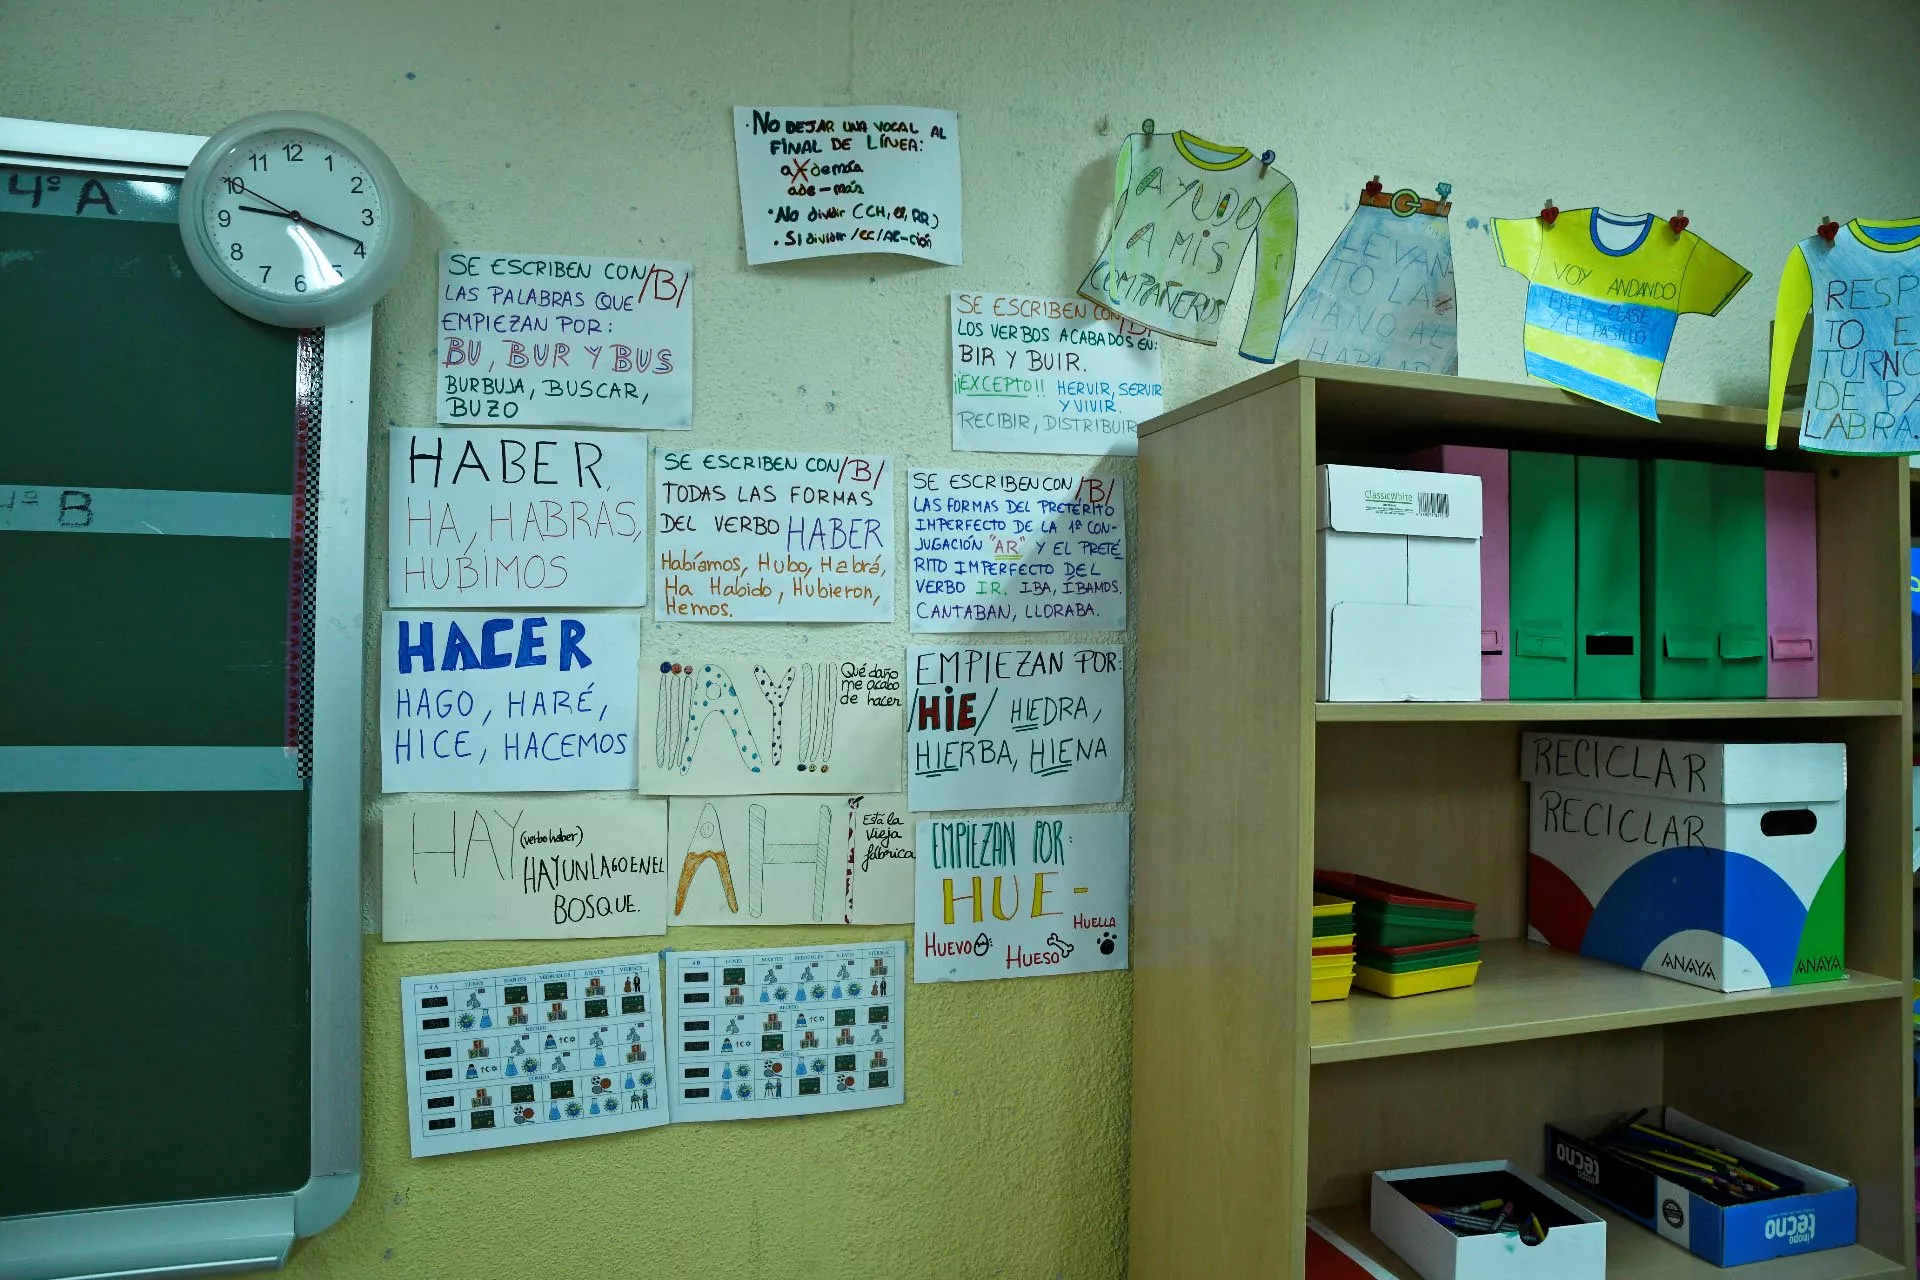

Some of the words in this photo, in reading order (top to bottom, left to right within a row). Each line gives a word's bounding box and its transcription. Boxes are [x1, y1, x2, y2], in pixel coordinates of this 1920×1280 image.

[786, 120, 834, 134] DEJAR
[842, 120, 867, 133] UNA
[874, 121, 918, 134] VOCAL
[931, 125, 946, 139] AL
[282, 145, 303, 162] 12
[831, 138, 852, 150] DE
[249, 154, 267, 171] 11
[325, 155, 332, 171] 1
[226, 177, 244, 194] 10
[351, 177, 363, 193] 2
[76, 179, 118, 215] A
[1136, 167, 1261, 230] AYUDO
[218, 210, 230, 227] 9
[362, 209, 373, 226] 3
[354, 242, 366, 258] 4
[1127, 223, 1154, 257] A
[230, 243, 243, 261] 8
[260, 266, 271, 283] 7
[449, 255, 480, 276] SE
[491, 259, 591, 278] ESCRIBEN
[605, 263, 647, 279] CON
[295, 275, 307, 293] 6
[1333, 259, 1375, 295] TO
[1388, 277, 1429, 308] LA
[1554, 261, 1592, 285] VOY
[1607, 278, 1676, 300] ANDANDO
[445, 285, 479, 301] LAS
[487, 286, 585, 307] PALABRAS
[595, 292, 633, 311] QUE
[957, 295, 982, 315] SE
[993, 298, 1086, 319] ESCRIBEN
[442, 313, 547, 332] EMPIEZAN
[957, 319, 983, 337] LOS
[991, 325, 1049, 343] VERBOS
[1060, 328, 1134, 347] ACABADOS
[1409, 320, 1442, 349] AL
[1825, 319, 1864, 350] TO
[502, 340, 570, 368] BUR
[584, 345, 603, 369] Y
[609, 344, 673, 374] BUS
[959, 345, 995, 366] BIR
[1007, 351, 1016, 369] Y
[1026, 350, 1086, 372] BUIR.
[542, 379, 648, 404] BUSCAR,
[1057, 380, 1115, 400] HERVIR,
[1119, 383, 1162, 396] SERVIR
[1815, 380, 1864, 411] DE
[446, 397, 518, 418] BUZO
[1059, 400, 1070, 412] Y
[957, 411, 1038, 434] RECIBIR,
[410, 436, 603, 488] HABER
[665, 453, 692, 470] SE
[703, 455, 797, 470] ESCRIBEN
[806, 457, 839, 473] CON
[663, 481, 726, 504] TODAS
[739, 486, 776, 502] LAS
[791, 486, 872, 506] FORMAS
[914, 473, 938, 491] SE
[950, 474, 1039, 492] ESCRIBEN
[1043, 477, 1072, 491] CON
[58, 491, 92, 527] B
[914, 497, 942, 513] LAS
[947, 500, 998, 513] FORMAS
[1006, 500, 1030, 514] DEL
[660, 513, 696, 533] DEL
[715, 515, 779, 535] VERBO
[787, 516, 883, 551] HABER
[915, 518, 1006, 531] IMPERFECTO
[1013, 520, 1032, 533] DE
[1042, 521, 1057, 533] LA
[1088, 522, 1118, 534] CON-
[1036, 542, 1045, 554] Y
[1054, 542, 1072, 555] EL
[914, 557, 947, 573] RITO
[954, 561, 1054, 575] IMPERFECTO
[1064, 562, 1101, 576] DEL
[665, 575, 693, 596] Ha
[916, 580, 965, 594] VERBO
[665, 596, 733, 617] Hemos.
[917, 602, 1017, 622] CANTABAN,
[1025, 604, 1099, 618] LLORABA.
[398, 617, 592, 674] HACER
[840, 662, 867, 679] Qué
[868, 662, 899, 681] daño
[917, 650, 1063, 685] EMPIEZAN
[841, 679, 862, 691] me
[867, 679, 900, 690] acabo
[840, 694, 858, 705] de
[868, 691, 902, 706] hacer
[505, 732, 627, 761] HACEMOS
[1031, 737, 1107, 774] HIENA
[1534, 737, 1706, 793] RECICLAR
[1539, 790, 1710, 856] RECICLAR
[412, 809, 524, 885] HAY
[555, 895, 641, 925] BOSQUE.
[1073, 913, 1116, 929] HUELLA
[925, 932, 972, 957] HUEVO
[1006, 945, 1059, 969] HUESO
[1661, 952, 1716, 980] ANAYA
[1795, 955, 1842, 974] ANAYA
[1765, 1213, 1815, 1239] tecno
